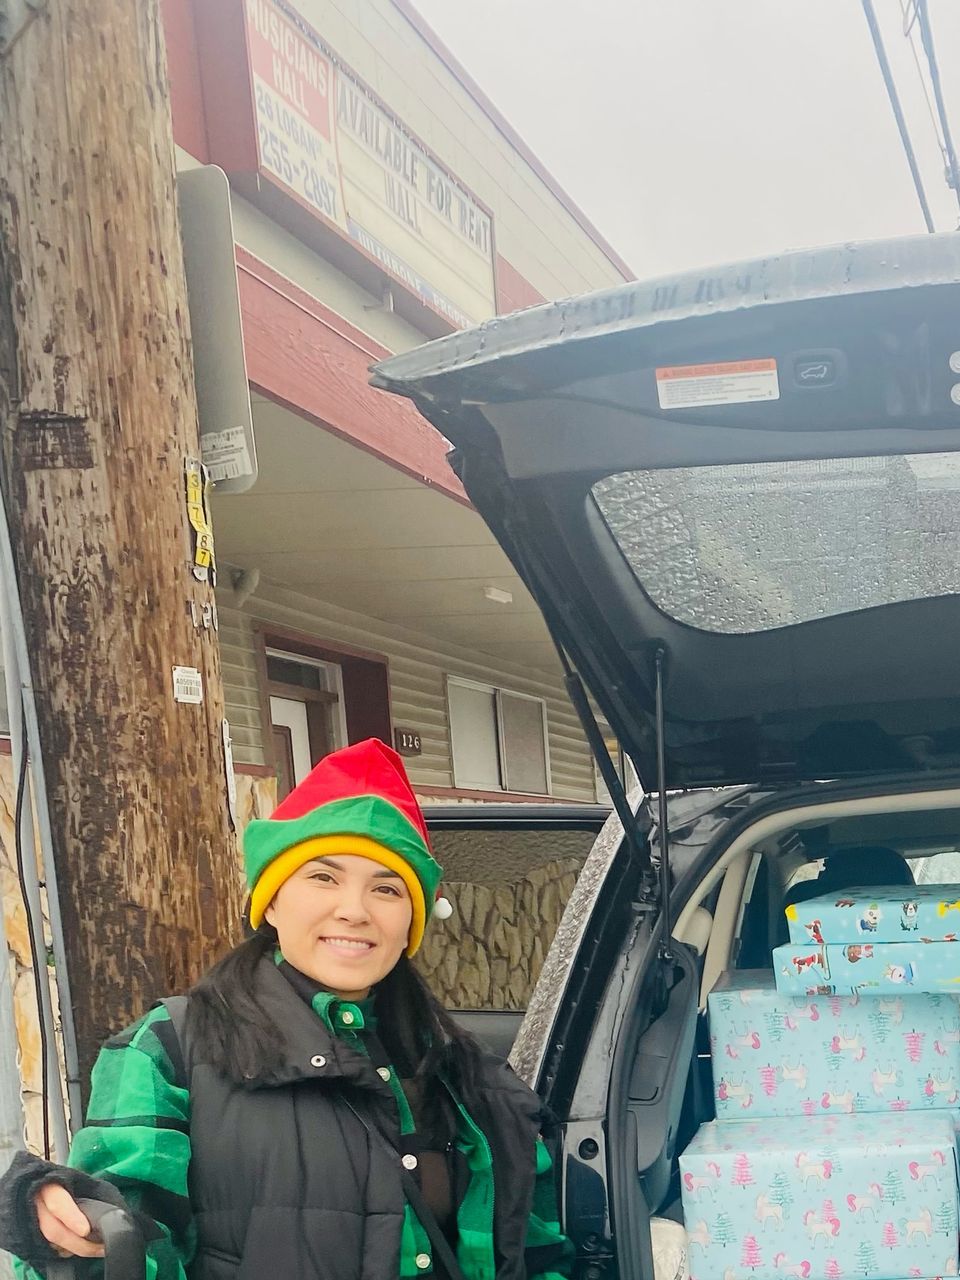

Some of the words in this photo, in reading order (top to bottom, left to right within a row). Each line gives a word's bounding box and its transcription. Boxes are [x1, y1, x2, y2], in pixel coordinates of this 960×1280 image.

[247, 0, 327, 97] MUSICIANS
[272, 54, 309, 117] HALL
[338, 78, 418, 190] AVAILABLE
[427, 167, 453, 222] FOR
[459, 198, 489, 253] RENT
[384, 170, 421, 237] HALL
[402, 734, 420, 749] 126
